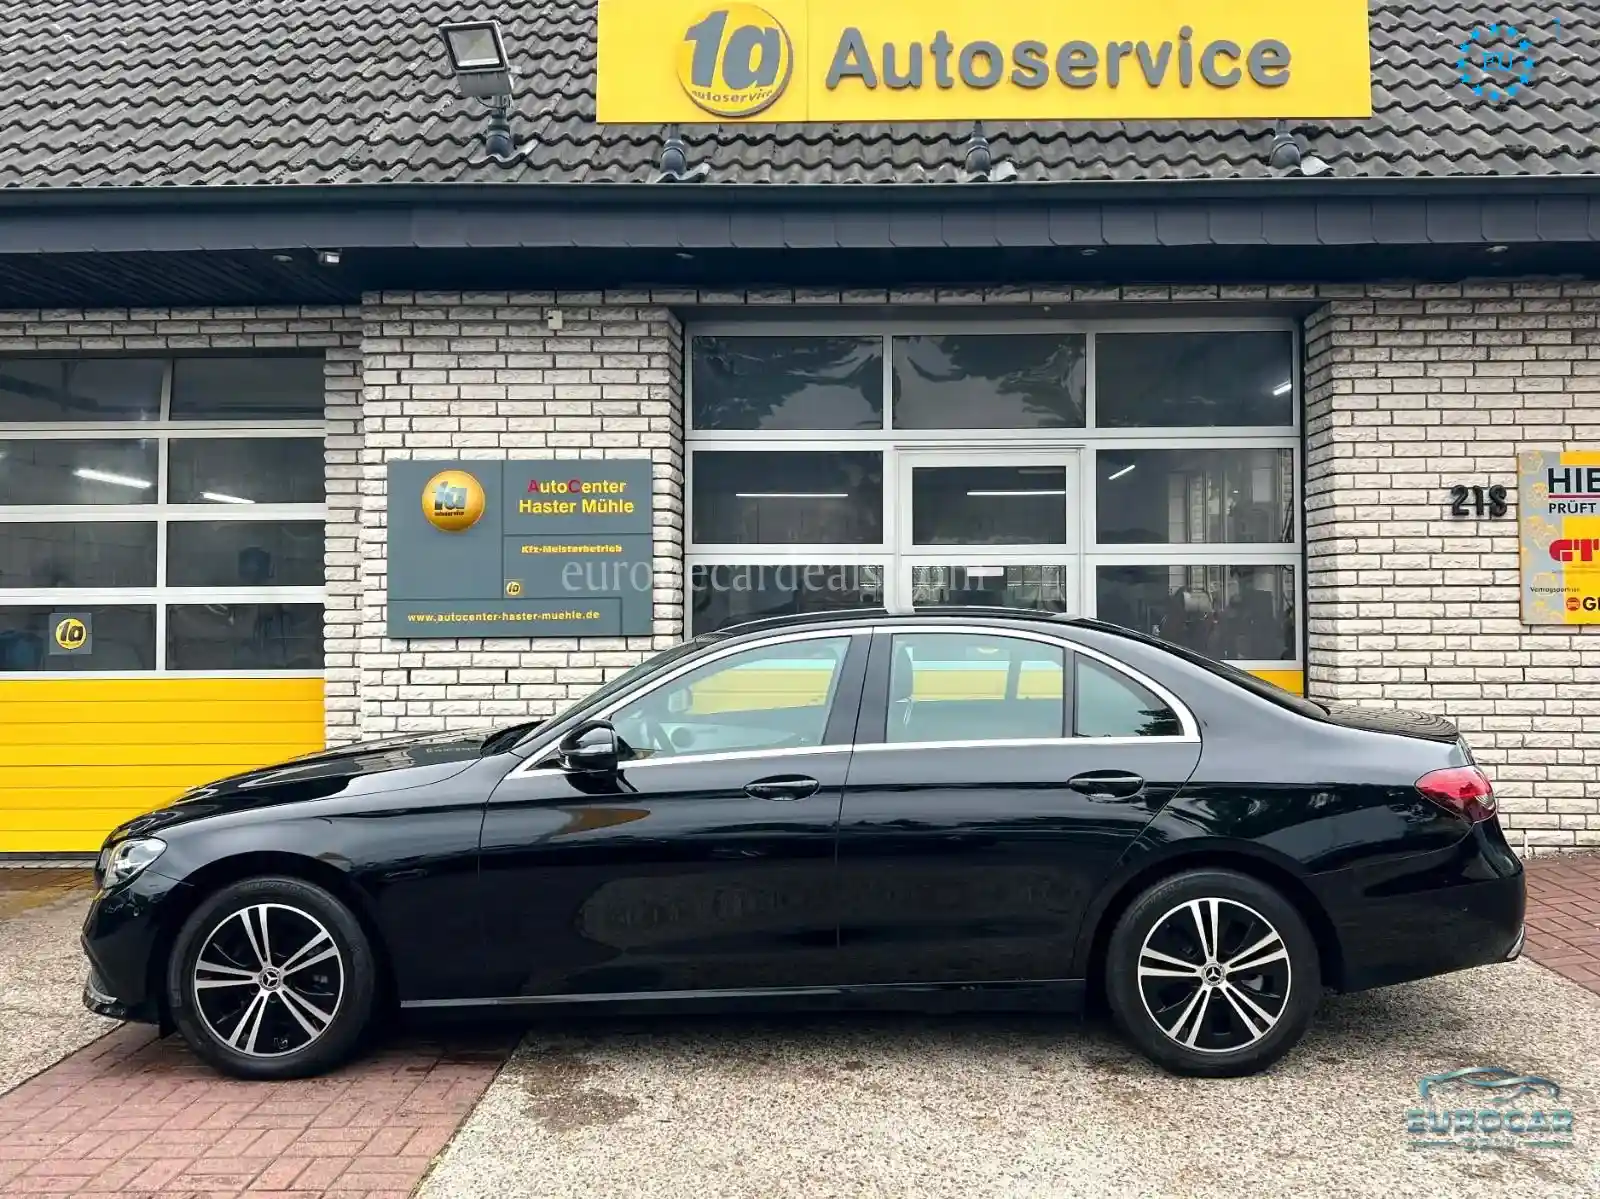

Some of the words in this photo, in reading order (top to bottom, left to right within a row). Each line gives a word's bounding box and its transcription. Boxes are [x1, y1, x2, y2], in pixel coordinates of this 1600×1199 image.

[684, 10, 780, 90] 1a
[825, 25, 1292, 90] Autoservice
[527, 479, 627, 494] AutoCenter
[519, 499, 578, 513] Haster
[581, 498, 635, 513] Mühle
[1548, 499, 1597, 514] PRÜFT
[521, 543, 624, 554] Kfz-Meisterbetrieb
[1582, 596, 1600, 611] G
[407, 609, 601, 623] www.autocenter-haster-muehle.de
